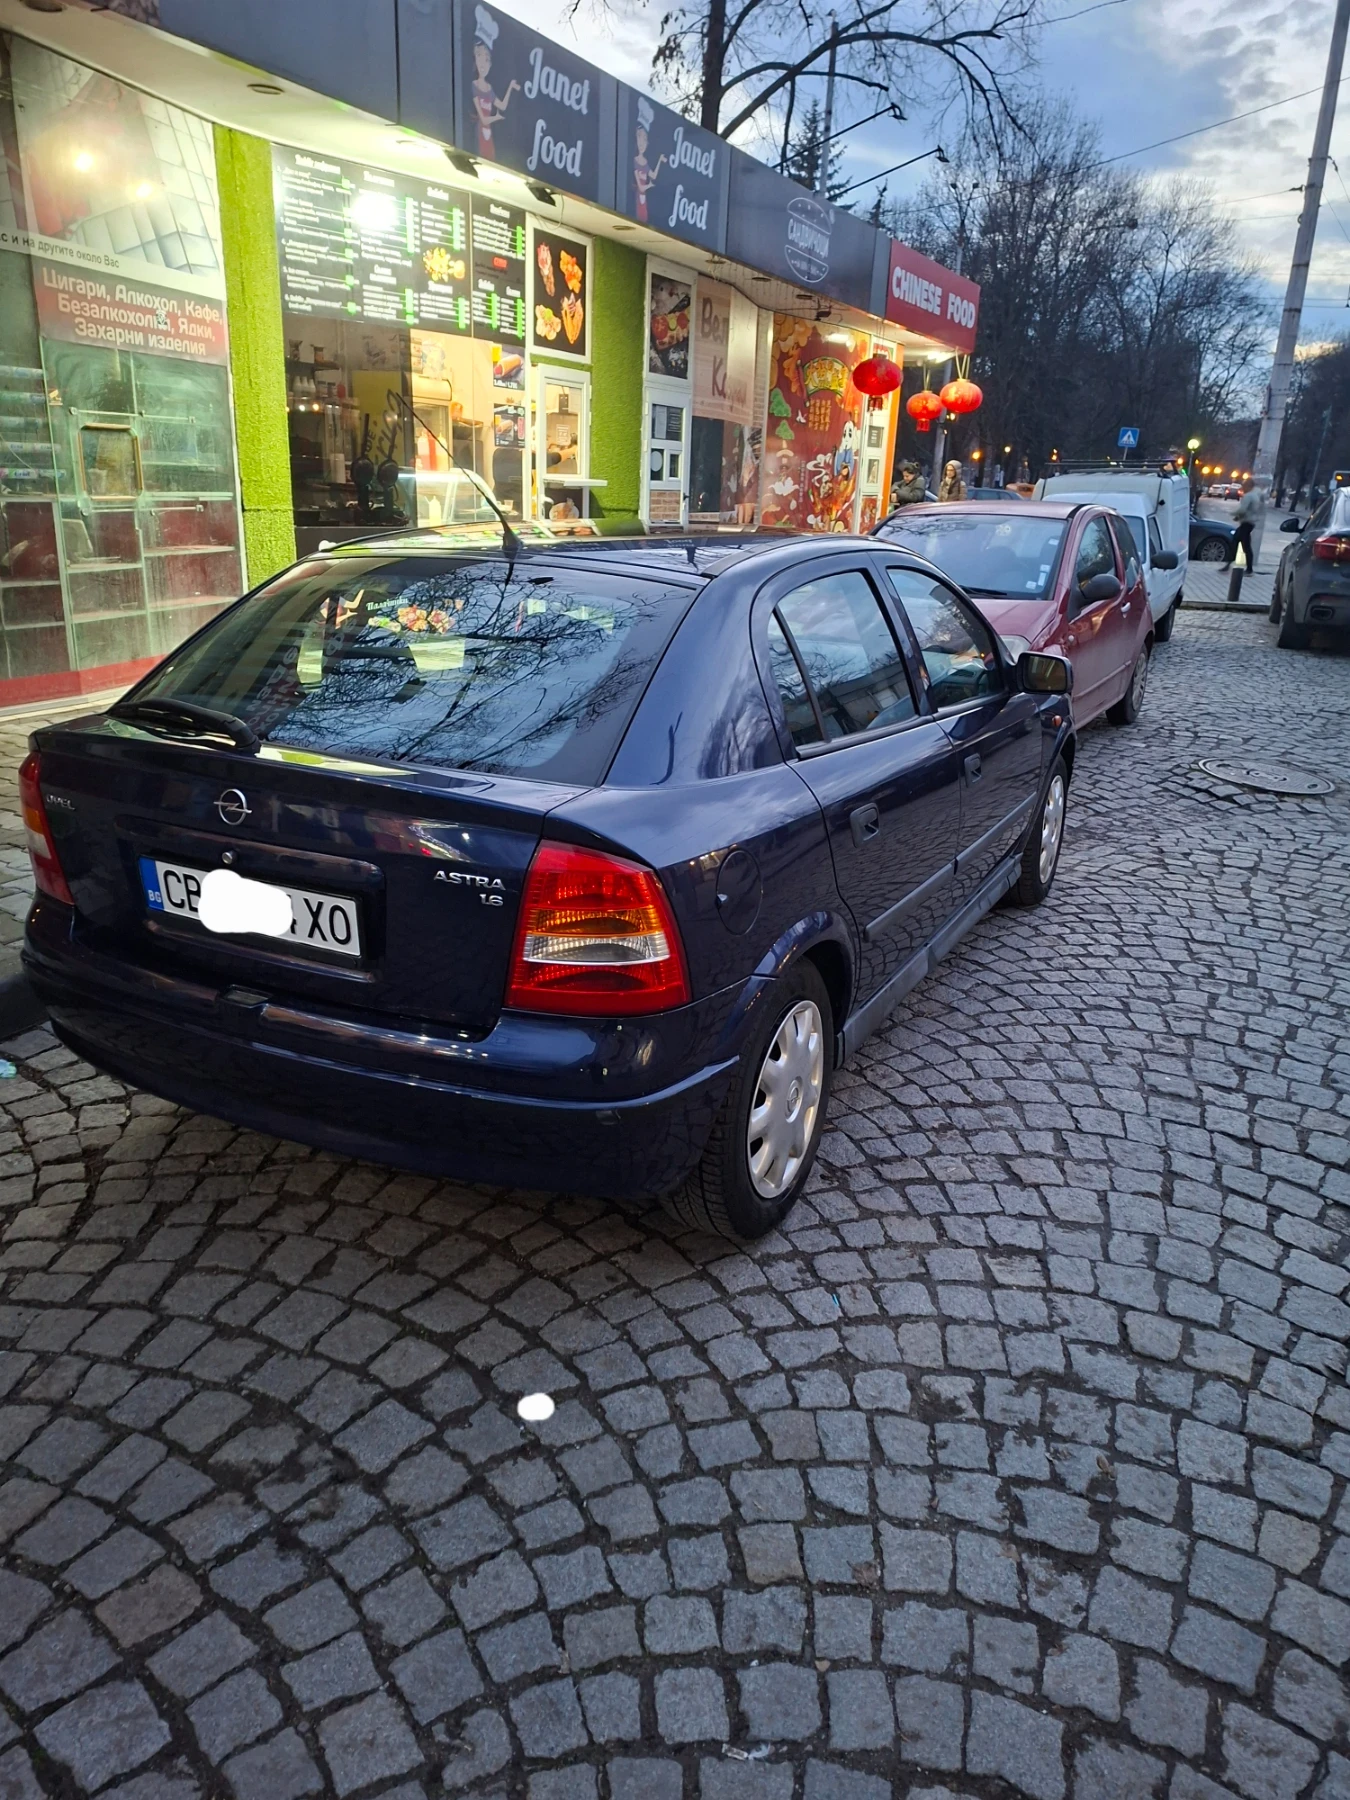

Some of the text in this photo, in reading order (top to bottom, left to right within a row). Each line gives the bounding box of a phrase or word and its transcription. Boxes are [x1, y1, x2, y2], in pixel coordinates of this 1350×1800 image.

[524, 47, 590, 115] Janet
[527, 118, 583, 177] food
[669, 126, 716, 178] Janet
[668, 184, 709, 230] food
[11, 235, 19, 245] и
[22, 237, 36, 248] на
[37, 240, 75, 257] другите
[76, 250, 102, 264] около
[103, 254, 120, 269] Вас
[42, 267, 223, 325] Цигари, Алкохол, Кафе,
[892, 266, 976, 329] CHINESE FOOD
[74, 318, 207, 356] Захарни изделия
[178, 317, 216, 342] Ядки,
[148, 889, 163, 904] BG
[433, 870, 507, 891] ASTRA
